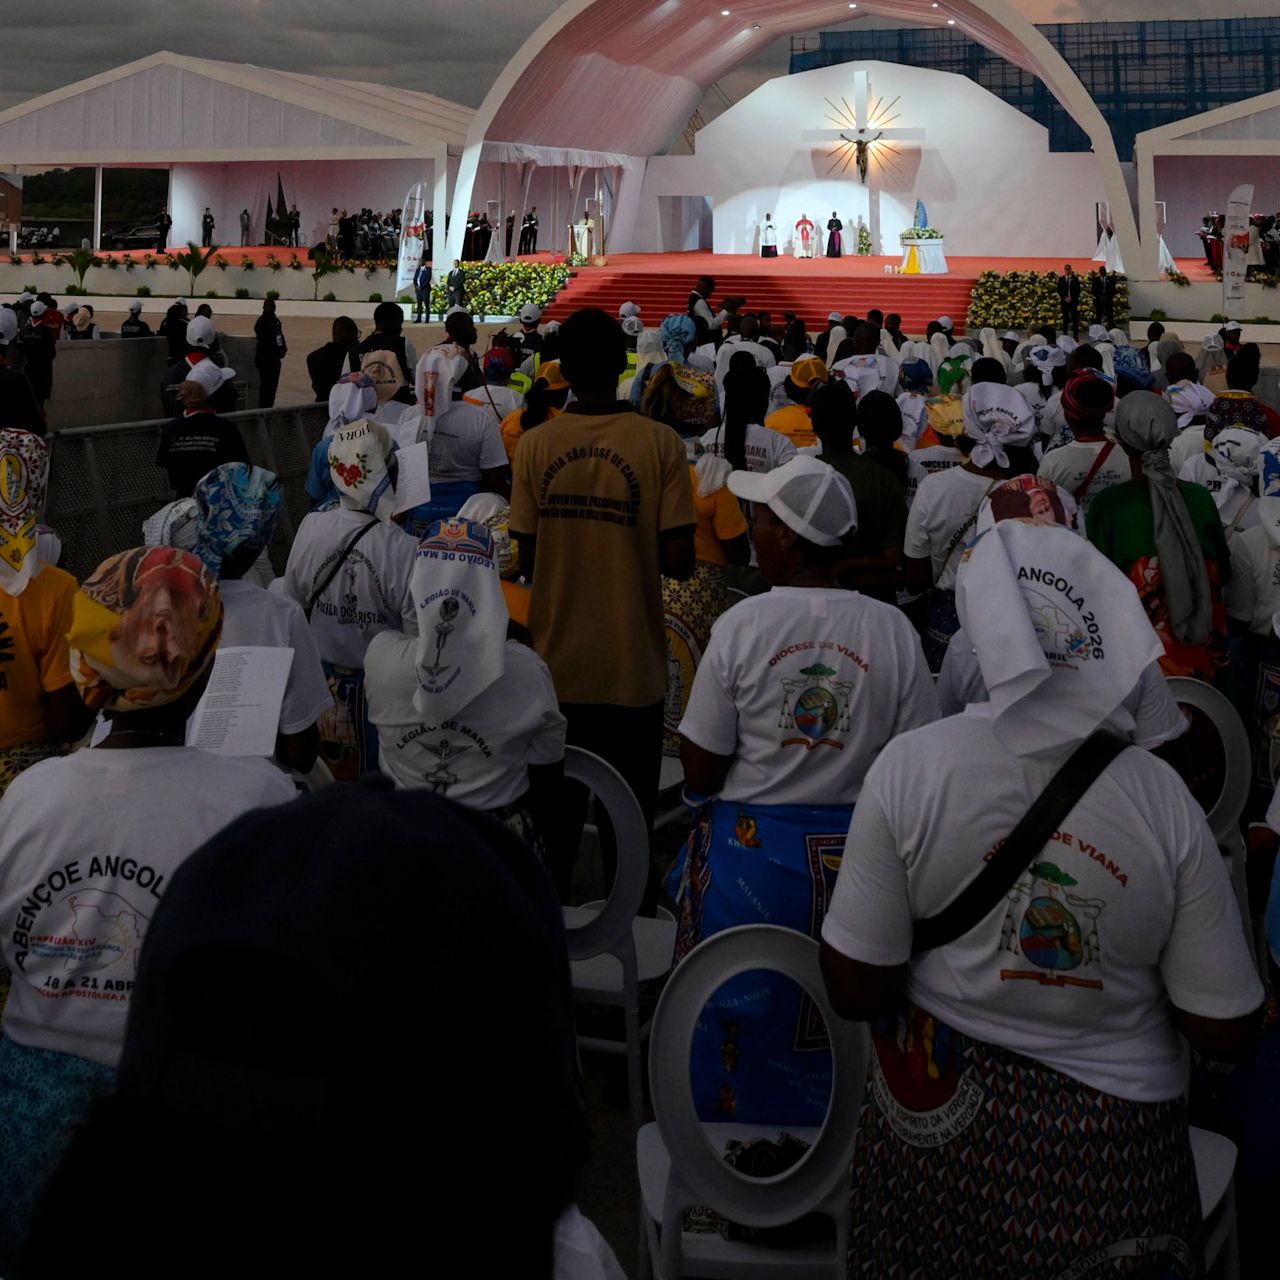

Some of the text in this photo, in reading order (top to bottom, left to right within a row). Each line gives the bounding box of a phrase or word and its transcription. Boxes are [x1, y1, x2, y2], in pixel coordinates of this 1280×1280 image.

[441, 551, 456, 561] DE
[1017, 566, 1105, 661] ANGOLA 2026
[768, 640, 870, 673] DIOCESE DE VIANA
[440, 720, 460, 731] DE
[459, 725, 493, 759] MARIA
[1049, 830, 1129, 888] DE VIANA
[13, 855, 165, 973] ABENÇOE ANGOL
[735, 876, 773, 922] MALANJE
[44, 975, 136, 992] 18 A 21 ABR
[950, 1086, 982, 1133] VERDADE
